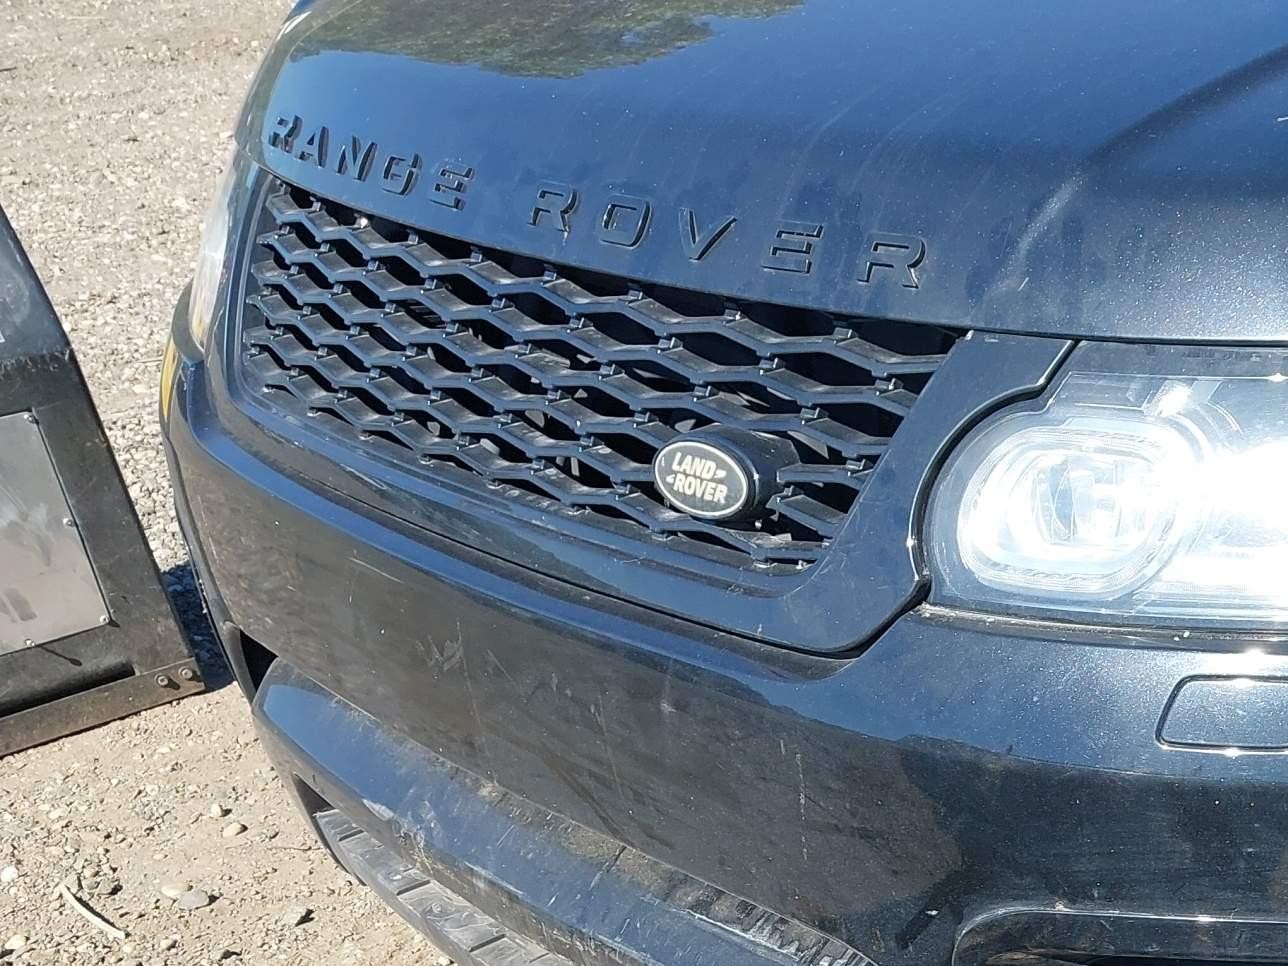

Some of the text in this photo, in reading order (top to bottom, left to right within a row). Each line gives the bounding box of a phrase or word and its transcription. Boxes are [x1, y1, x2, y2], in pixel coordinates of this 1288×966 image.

[267, 114, 929, 290] RANGE ROVER
[672, 451, 717, 480] LAND
[673, 472, 728, 504] ROVER
